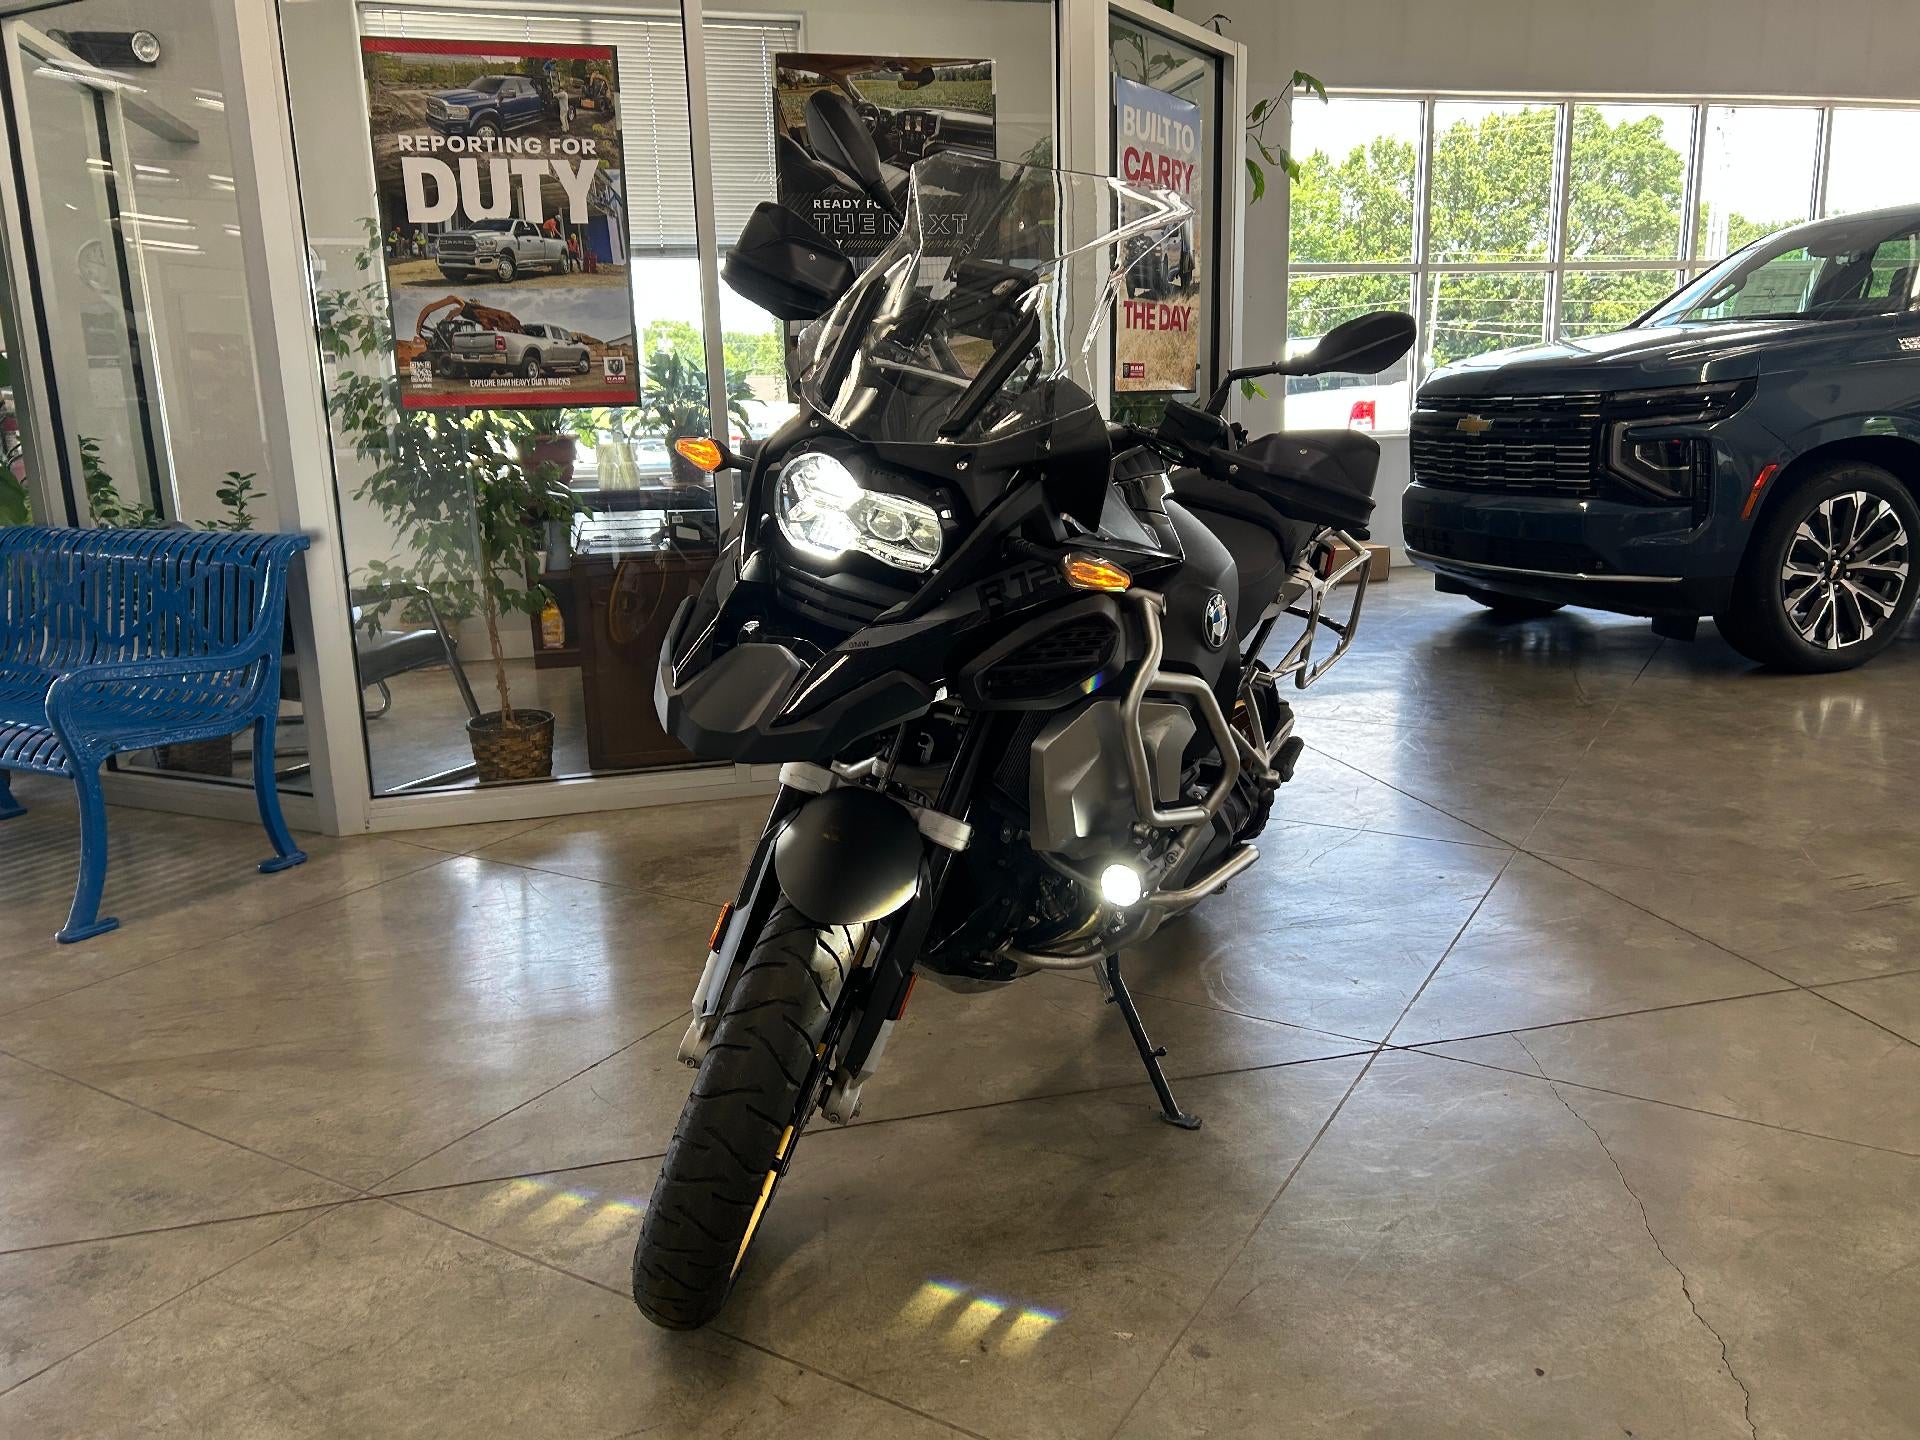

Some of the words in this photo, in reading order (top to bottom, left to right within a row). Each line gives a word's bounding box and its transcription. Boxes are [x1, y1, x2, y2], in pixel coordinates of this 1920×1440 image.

[1123, 104, 1171, 148] BUILT
[1173, 120, 1195, 154] TO
[397, 134, 542, 154] REPORTING
[550, 138, 597, 155] FOR
[1123, 146, 1194, 194] CARRY
[401, 157, 600, 224] DUTY
[813, 199, 861, 209] READY
[813, 213, 876, 235] THE
[883, 213, 968, 235] NXT
[1123, 300, 1156, 330] THE
[1158, 303, 1191, 332] DAY
[470, 378, 496, 388] EXPLORE
[496, 378, 511, 387] RAM
[511, 377, 531, 387] HEAVY
[531, 376, 547, 386] DUTY
[547, 376, 571, 386] TRUCKS
